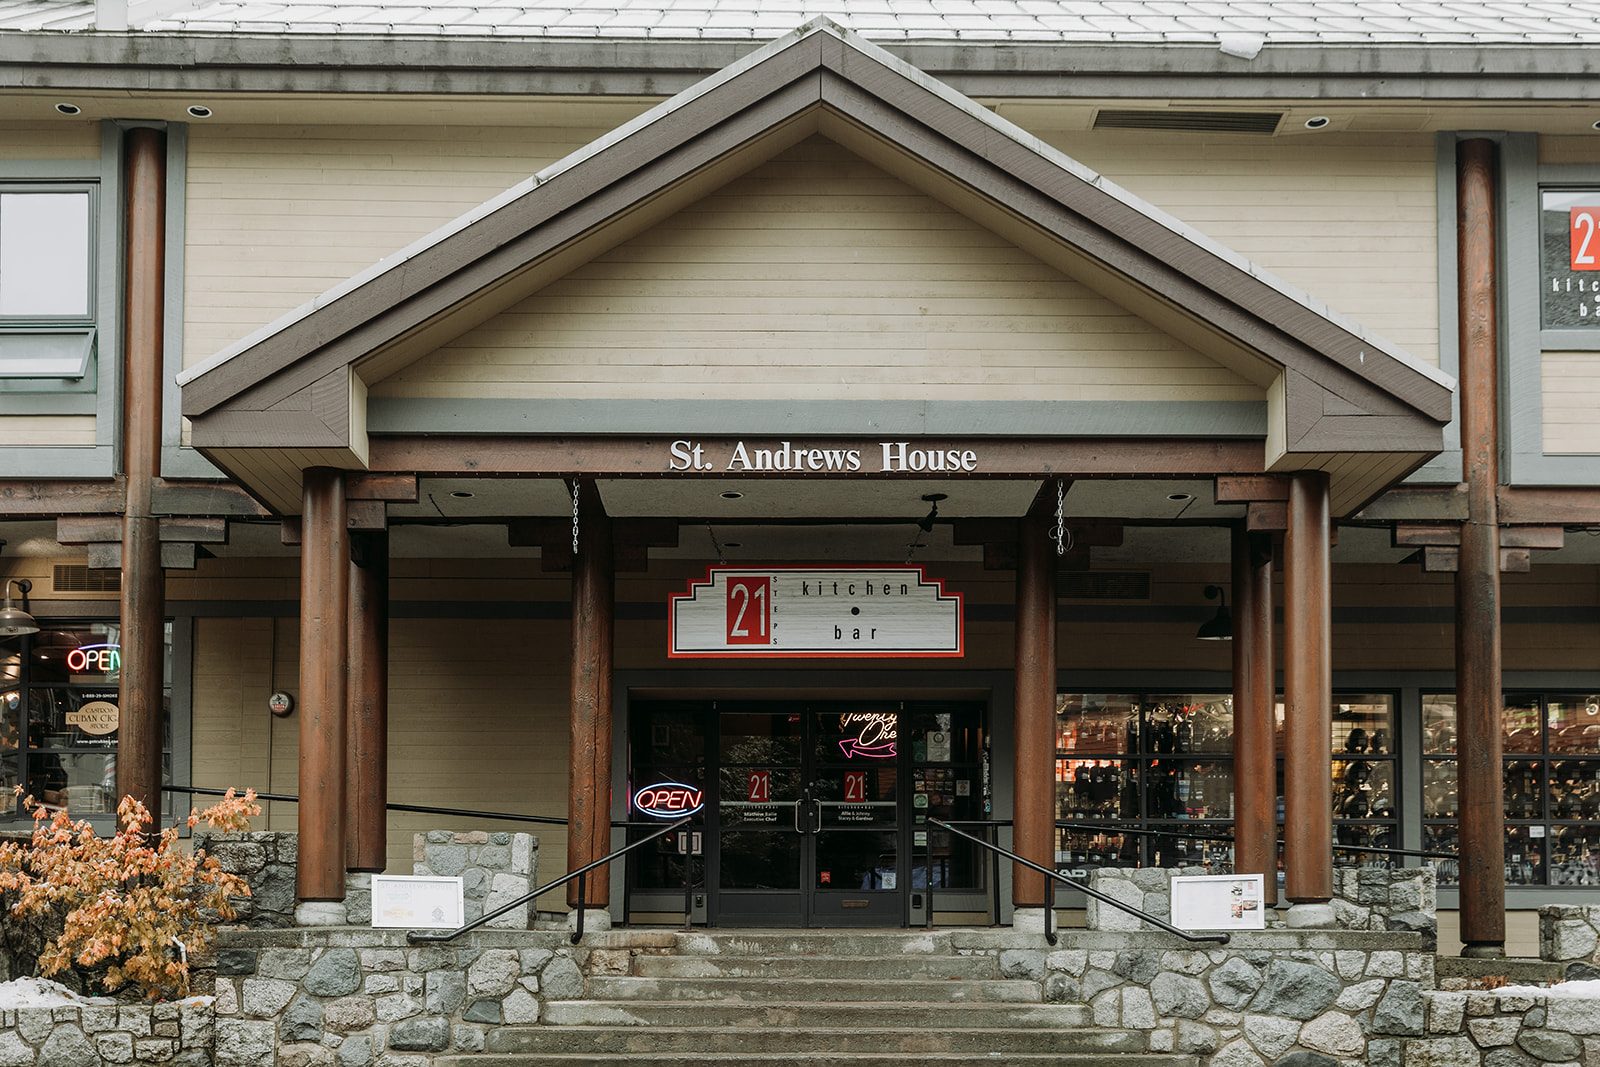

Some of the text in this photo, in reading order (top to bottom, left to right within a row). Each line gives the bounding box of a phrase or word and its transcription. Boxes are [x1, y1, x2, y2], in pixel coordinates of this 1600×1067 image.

[1574, 212, 1600, 264] 2
[669, 440, 977, 472] St. Andrews House
[802, 580, 908, 596] kitchen
[730, 583, 766, 637] 21
[834, 624, 877, 640] bar
[68, 714, 118, 723] CUBAN CIG
[750, 774, 768, 799] 21
[846, 774, 864, 799] 21
[637, 790, 702, 809] OPEN
[1057, 869, 1087, 878] AD
